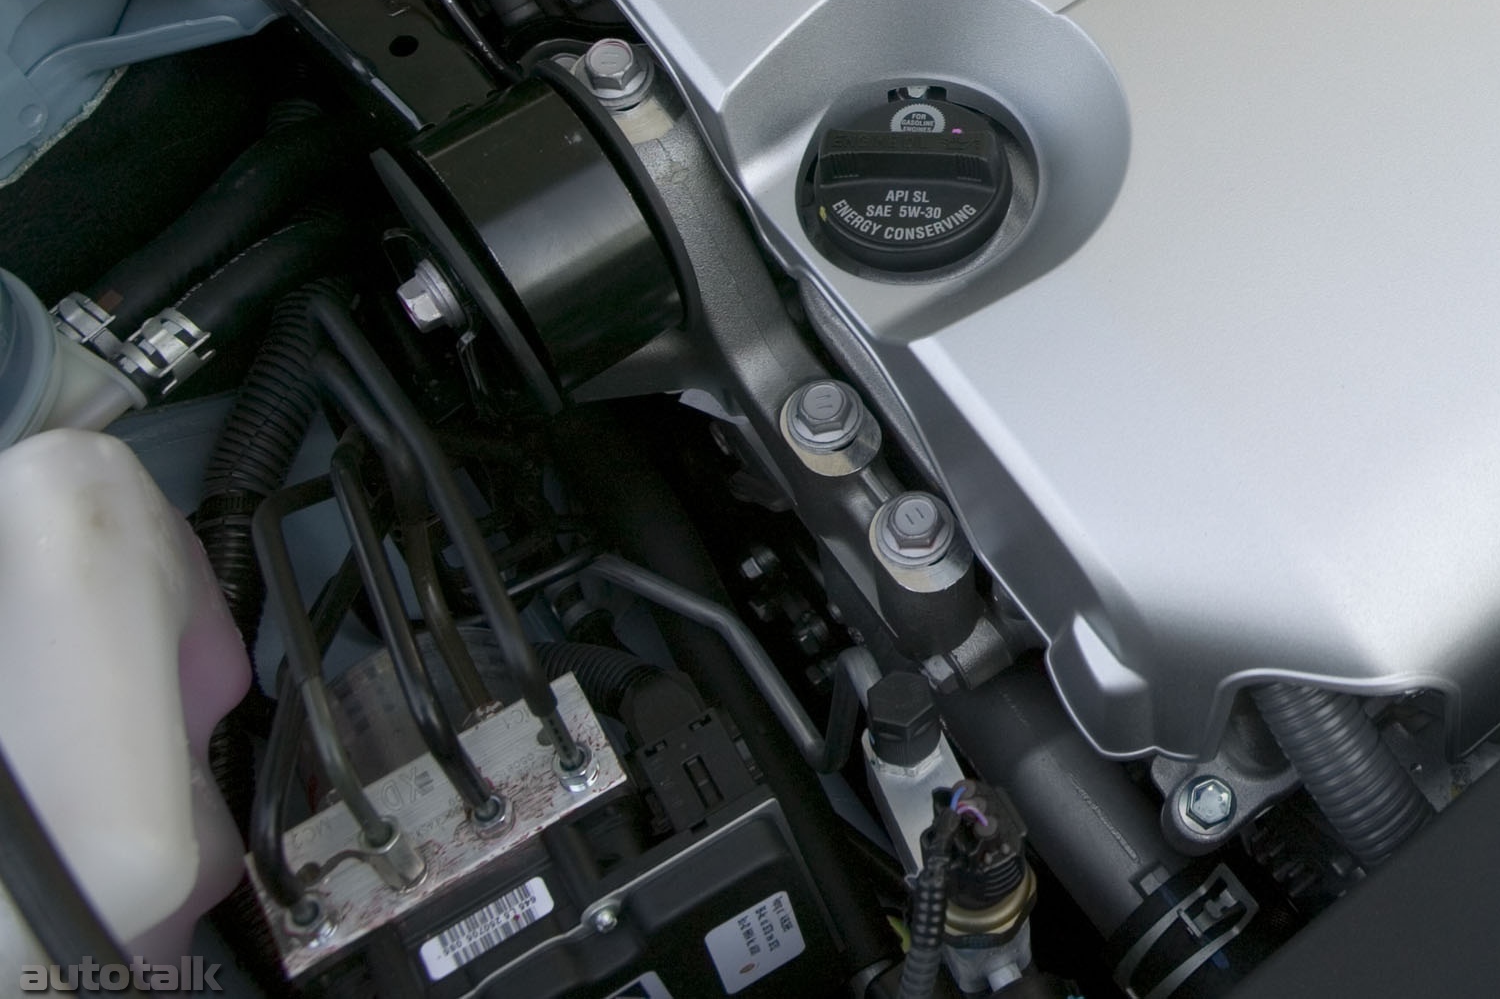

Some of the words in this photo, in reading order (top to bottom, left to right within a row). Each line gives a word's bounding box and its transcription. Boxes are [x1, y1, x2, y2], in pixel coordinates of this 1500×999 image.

[901, 119, 936, 127] GASOLINE
[885, 189, 909, 202] API
[912, 190, 930, 203] SL
[865, 205, 892, 218] SAE
[899, 205, 942, 219] 5W-30
[832, 199, 881, 237] ENERGY
[883, 203, 977, 241] CONSERVING
